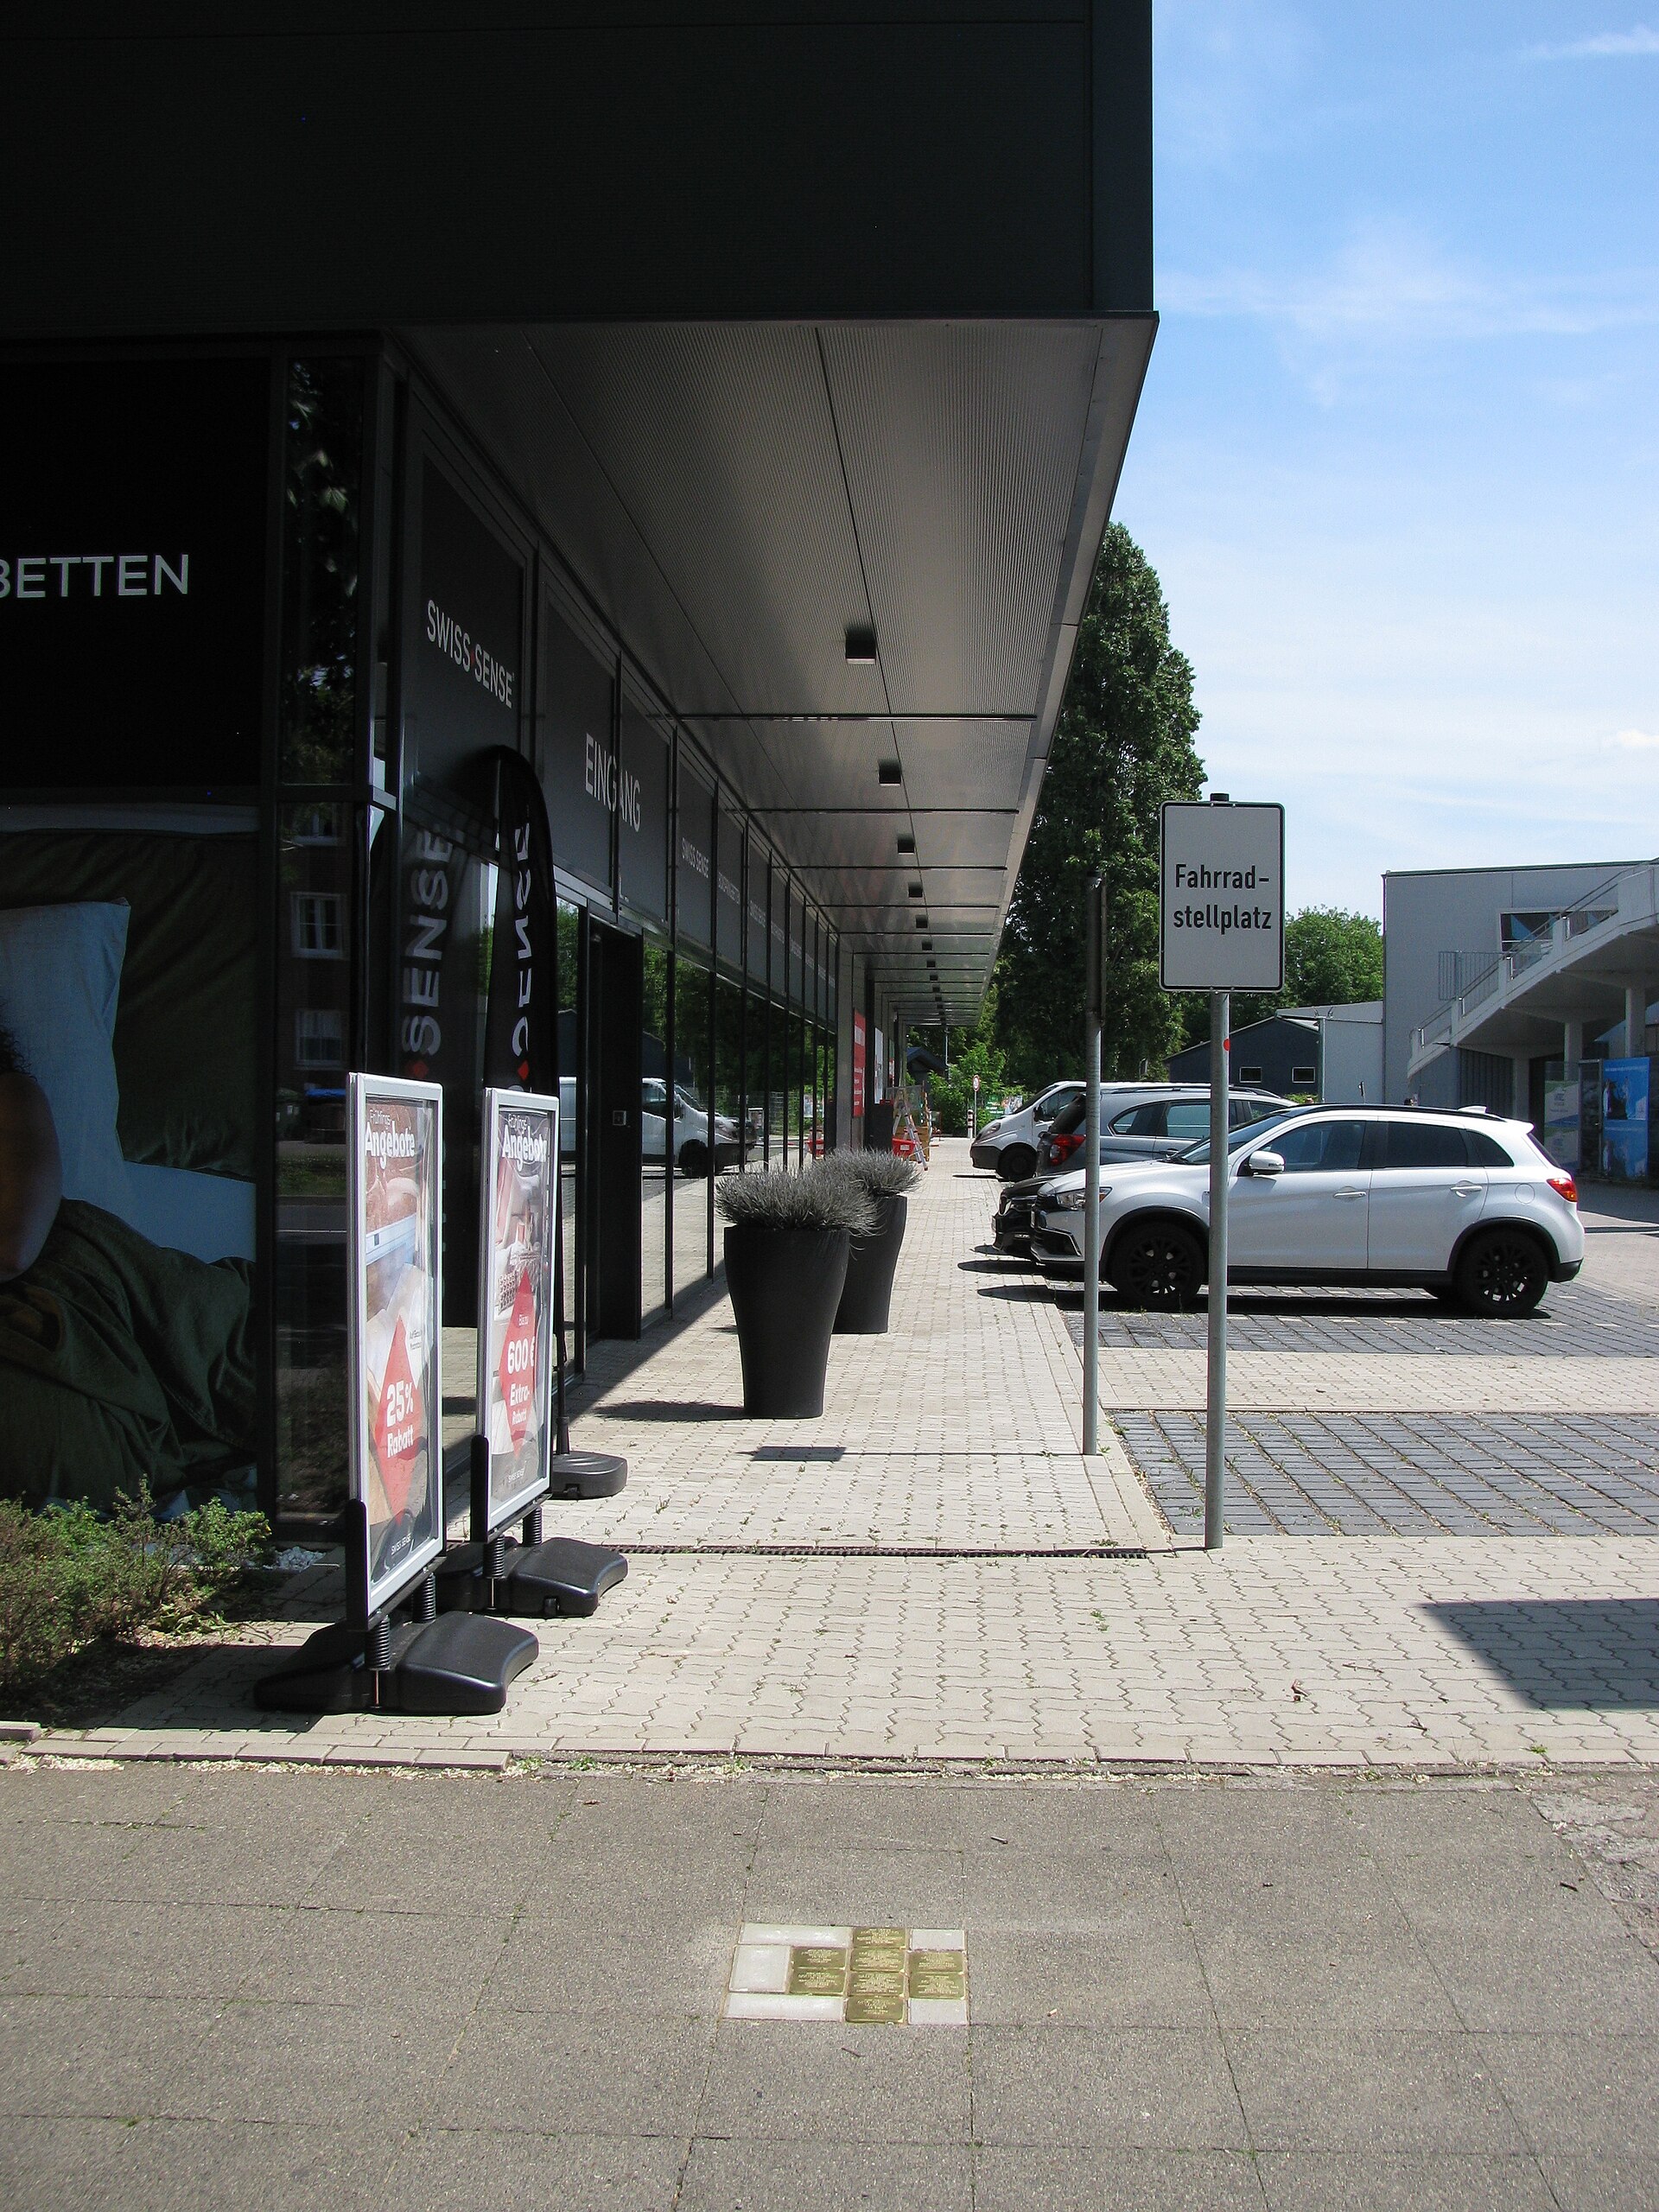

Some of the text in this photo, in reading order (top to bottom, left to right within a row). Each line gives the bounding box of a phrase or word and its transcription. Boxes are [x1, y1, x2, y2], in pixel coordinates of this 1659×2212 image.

[427, 600, 512, 709] SWISS SENSE
[1175, 864, 1269, 889] Fahrrad-
[1173, 905, 1272, 935] stellplatz
[365, 1121, 415, 1170] Angebote
[507, 1338, 529, 1375] 600
[387, 1425, 414, 1459] Rabatt
